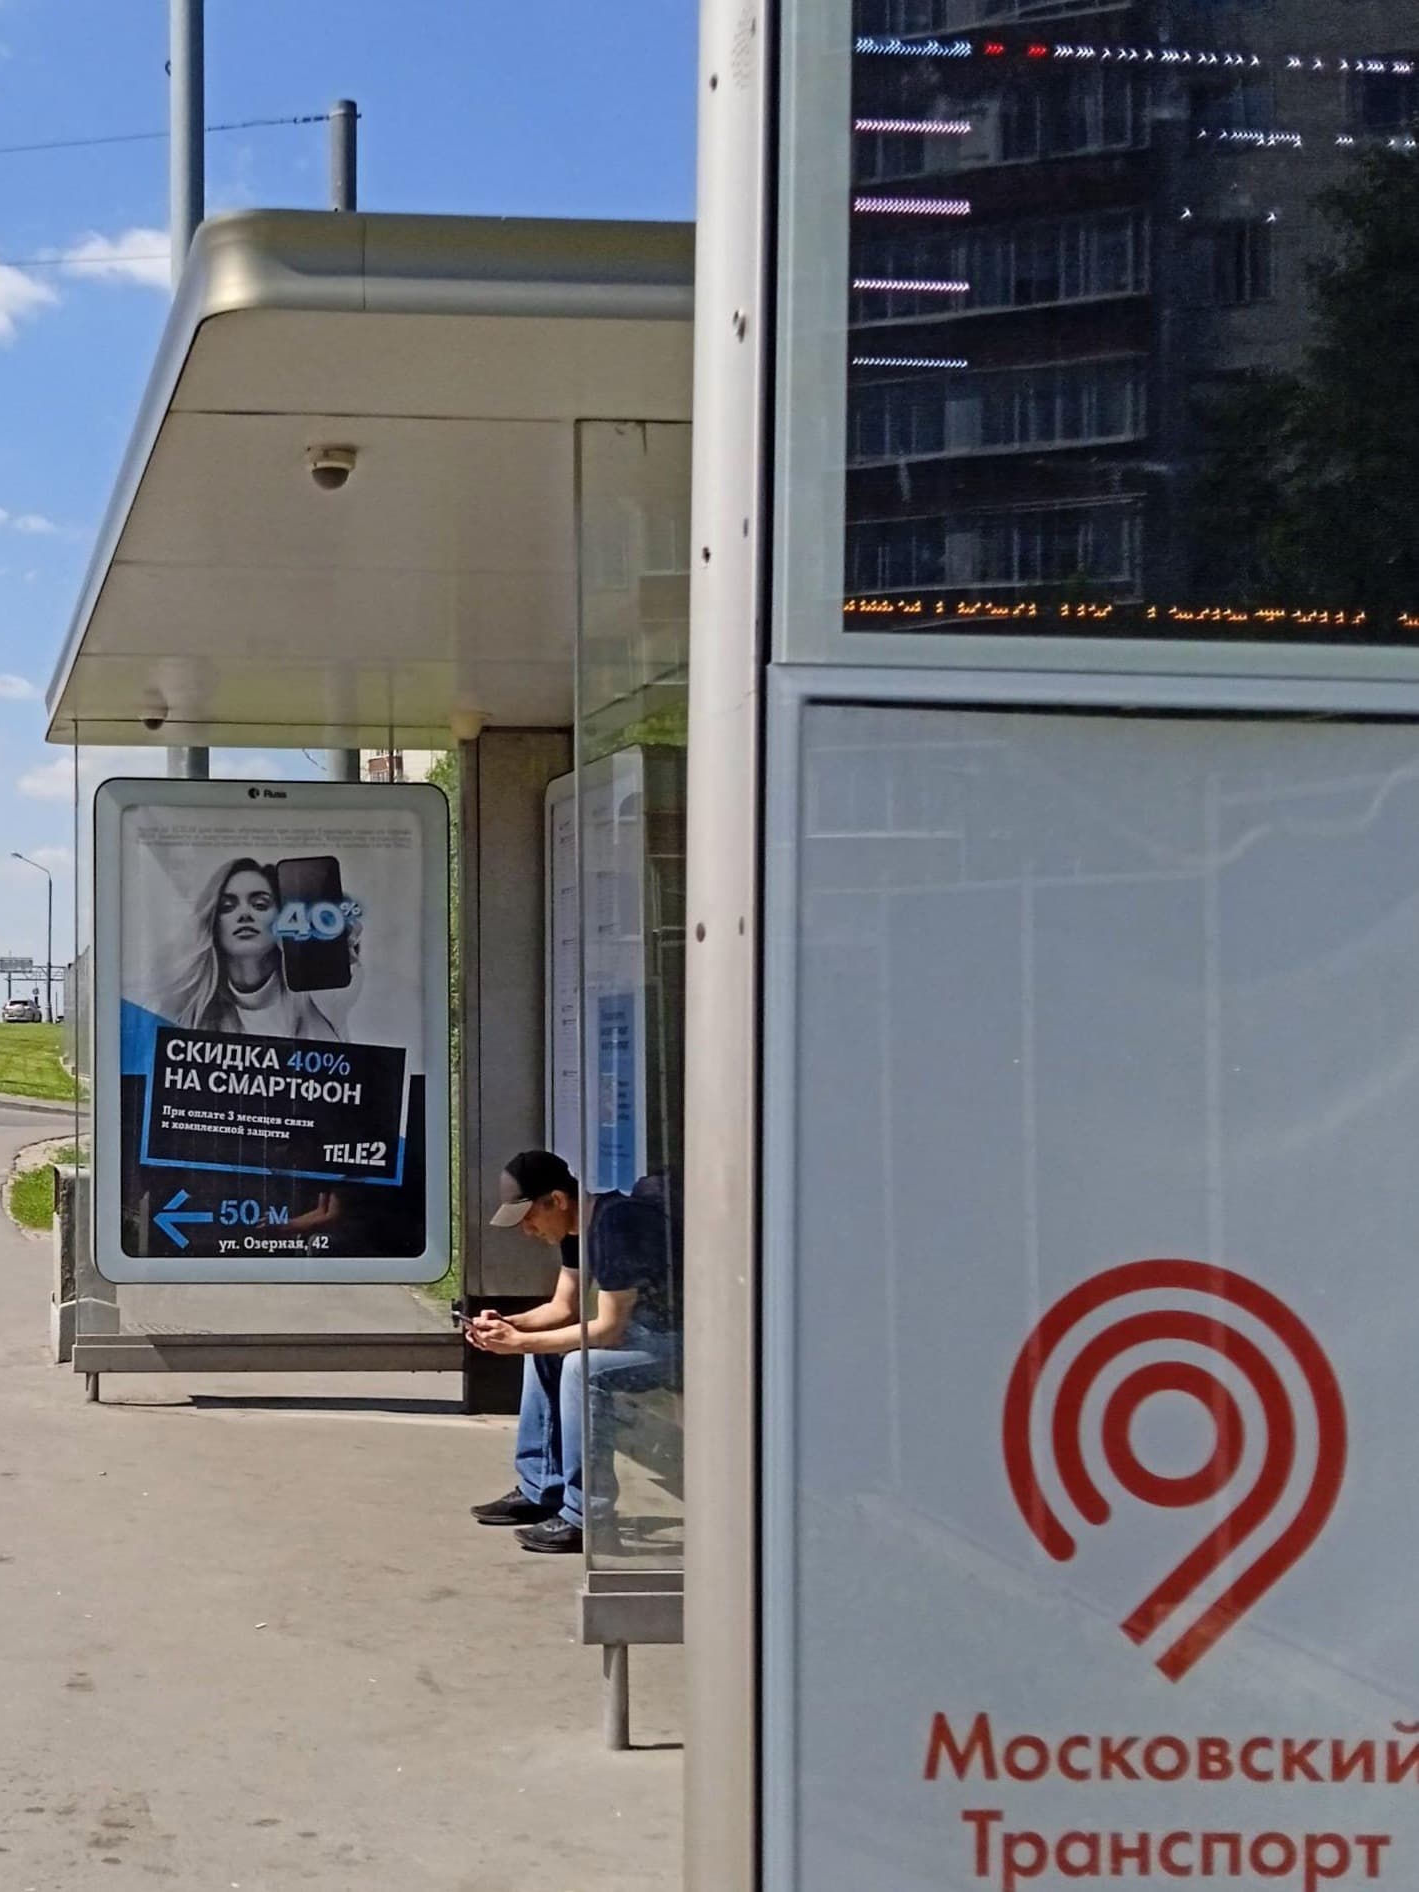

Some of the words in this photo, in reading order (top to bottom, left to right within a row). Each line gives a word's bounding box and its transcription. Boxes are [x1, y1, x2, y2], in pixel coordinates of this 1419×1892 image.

[273, 902, 362, 941] 40%
[166, 1038, 281, 1072] СКИДКА
[287, 1050, 351, 1076] 40%
[164, 1067, 202, 1092] НА
[208, 1071, 362, 1105] СМАРТФОН
[161, 1120, 170, 1129] и
[171, 1121, 245, 1136] комплексной
[246, 1128, 290, 1139] защиты
[162, 1105, 186, 1119] При
[187, 1109, 226, 1121] оплате
[227, 1110, 235, 1121] 3
[237, 1113, 282, 1126] месяцев
[284, 1117, 315, 1128] связи
[323, 1141, 387, 1166] TELE2
[219, 1199, 261, 1225] 50
[218, 1239, 240, 1253] ул.
[243, 1236, 309, 1253] Озерная,
[311, 1235, 330, 1249] 42
[923, 1711, 1419, 1784] Московский
[961, 1809, 1392, 1892] Транспорт
